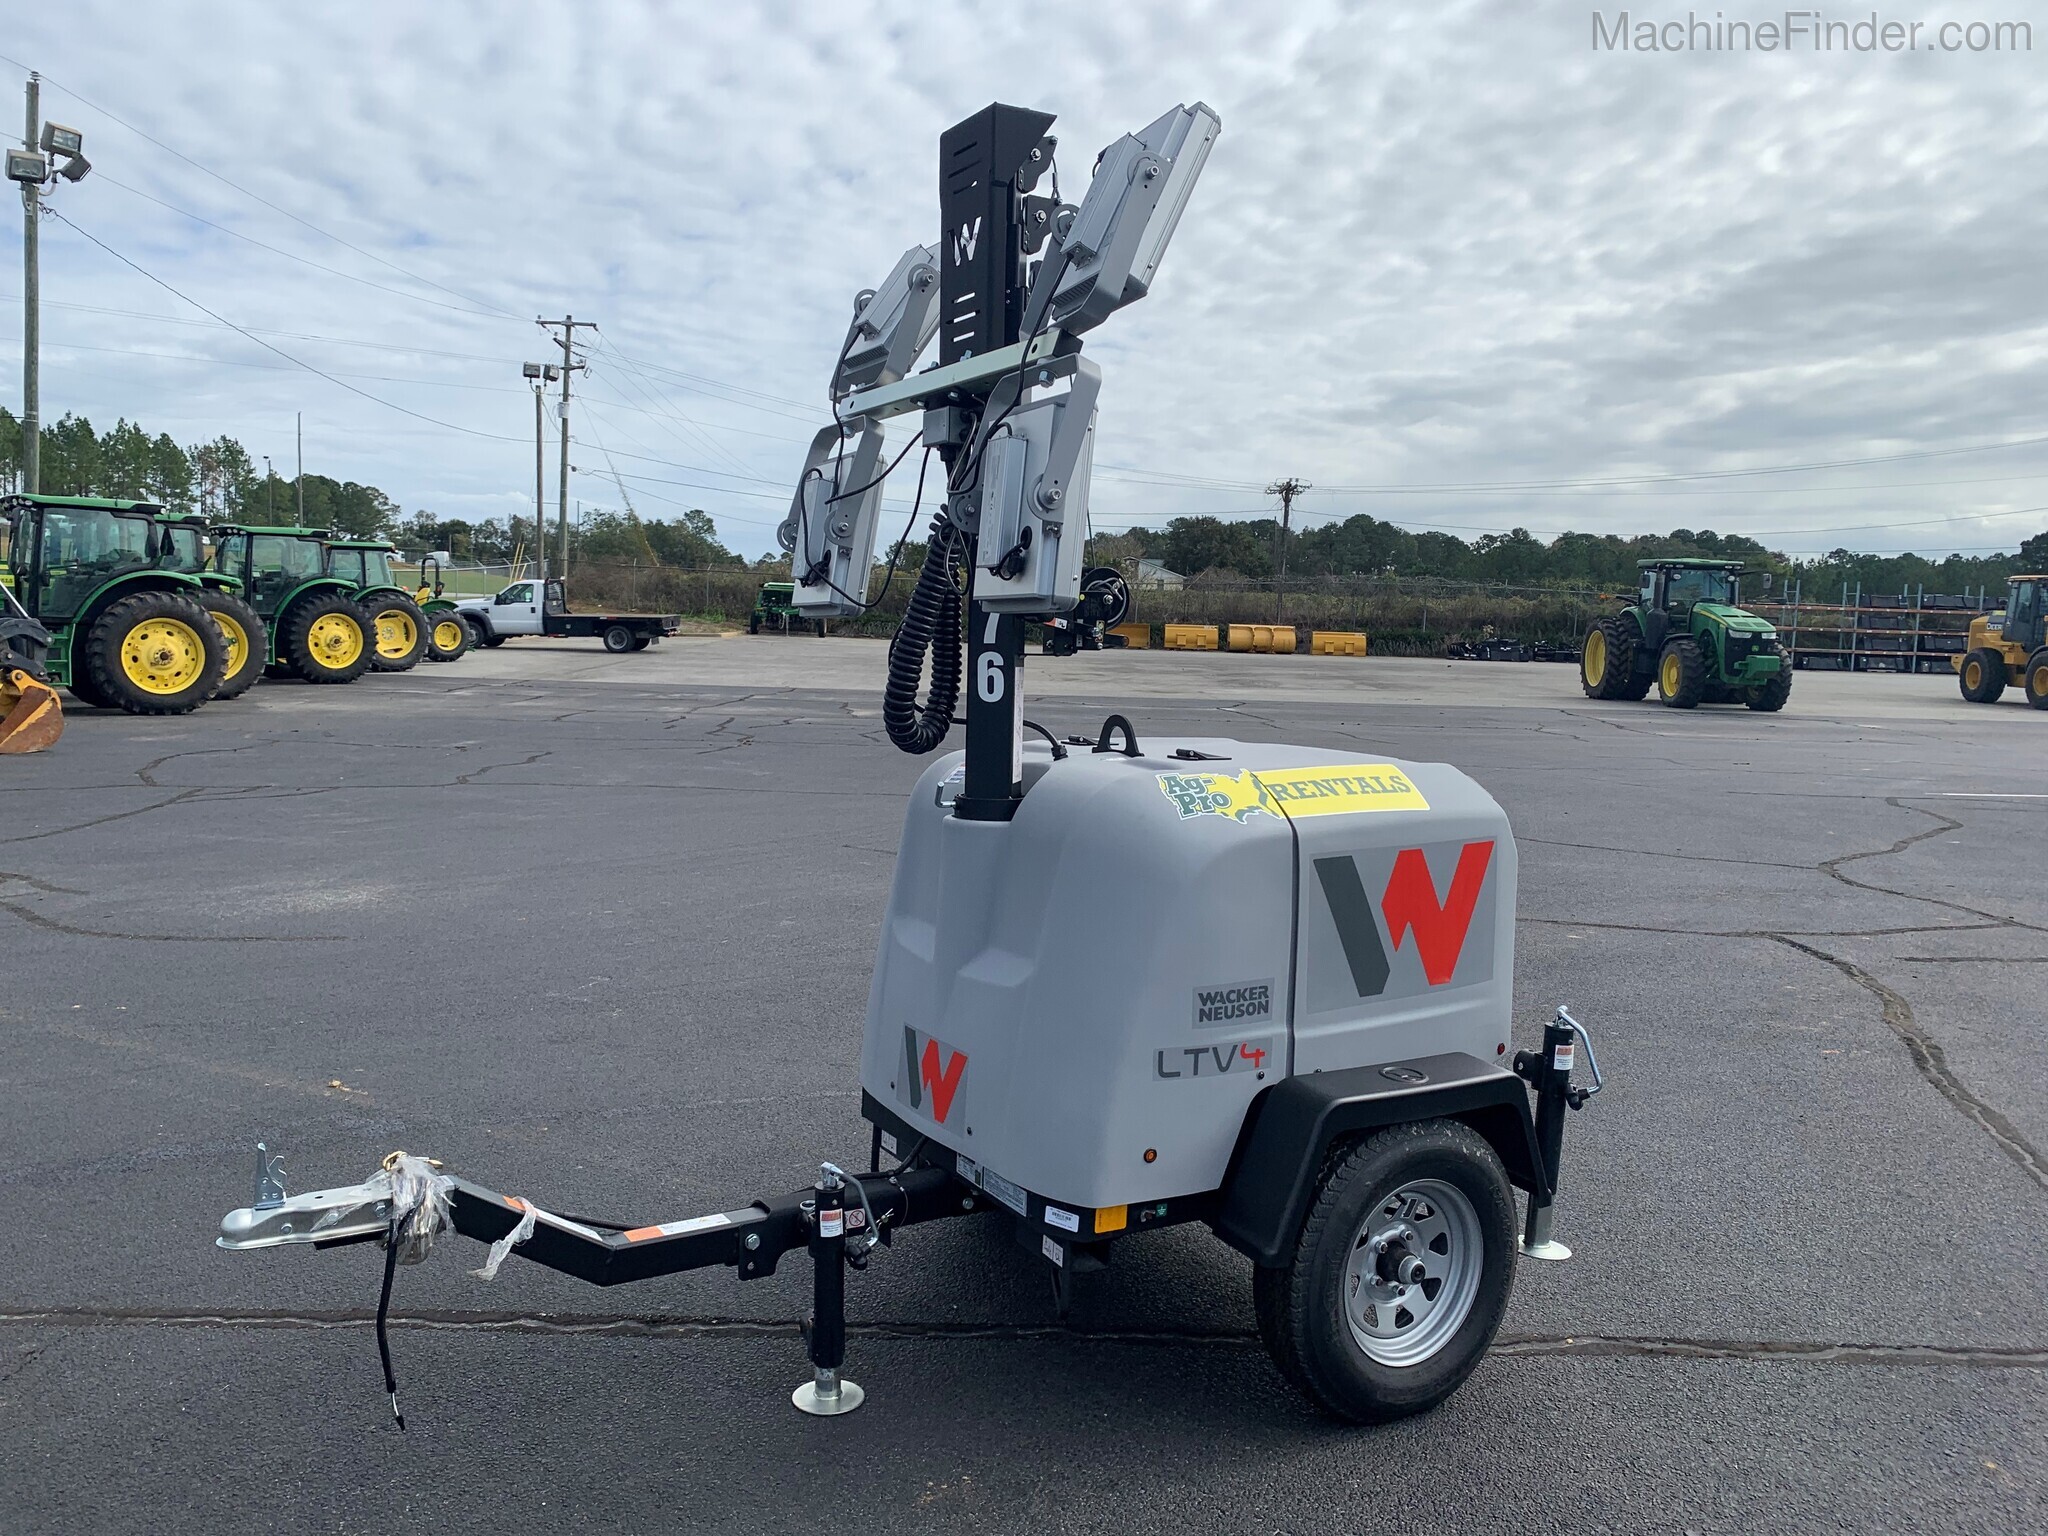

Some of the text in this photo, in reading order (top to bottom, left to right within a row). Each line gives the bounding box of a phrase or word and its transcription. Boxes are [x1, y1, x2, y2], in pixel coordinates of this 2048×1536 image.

[1986, 623, 2003, 631] DEER
[1271, 775, 1411, 801] RENTALS
[1174, 790, 1232, 815] Pro
[1313, 840, 1495, 998] W
[1198, 985, 1269, 1007] WACKER
[1199, 999, 1269, 1022] NEUSON
[1158, 1042, 1266, 1078] LTV4
[905, 1026, 968, 1124] W
